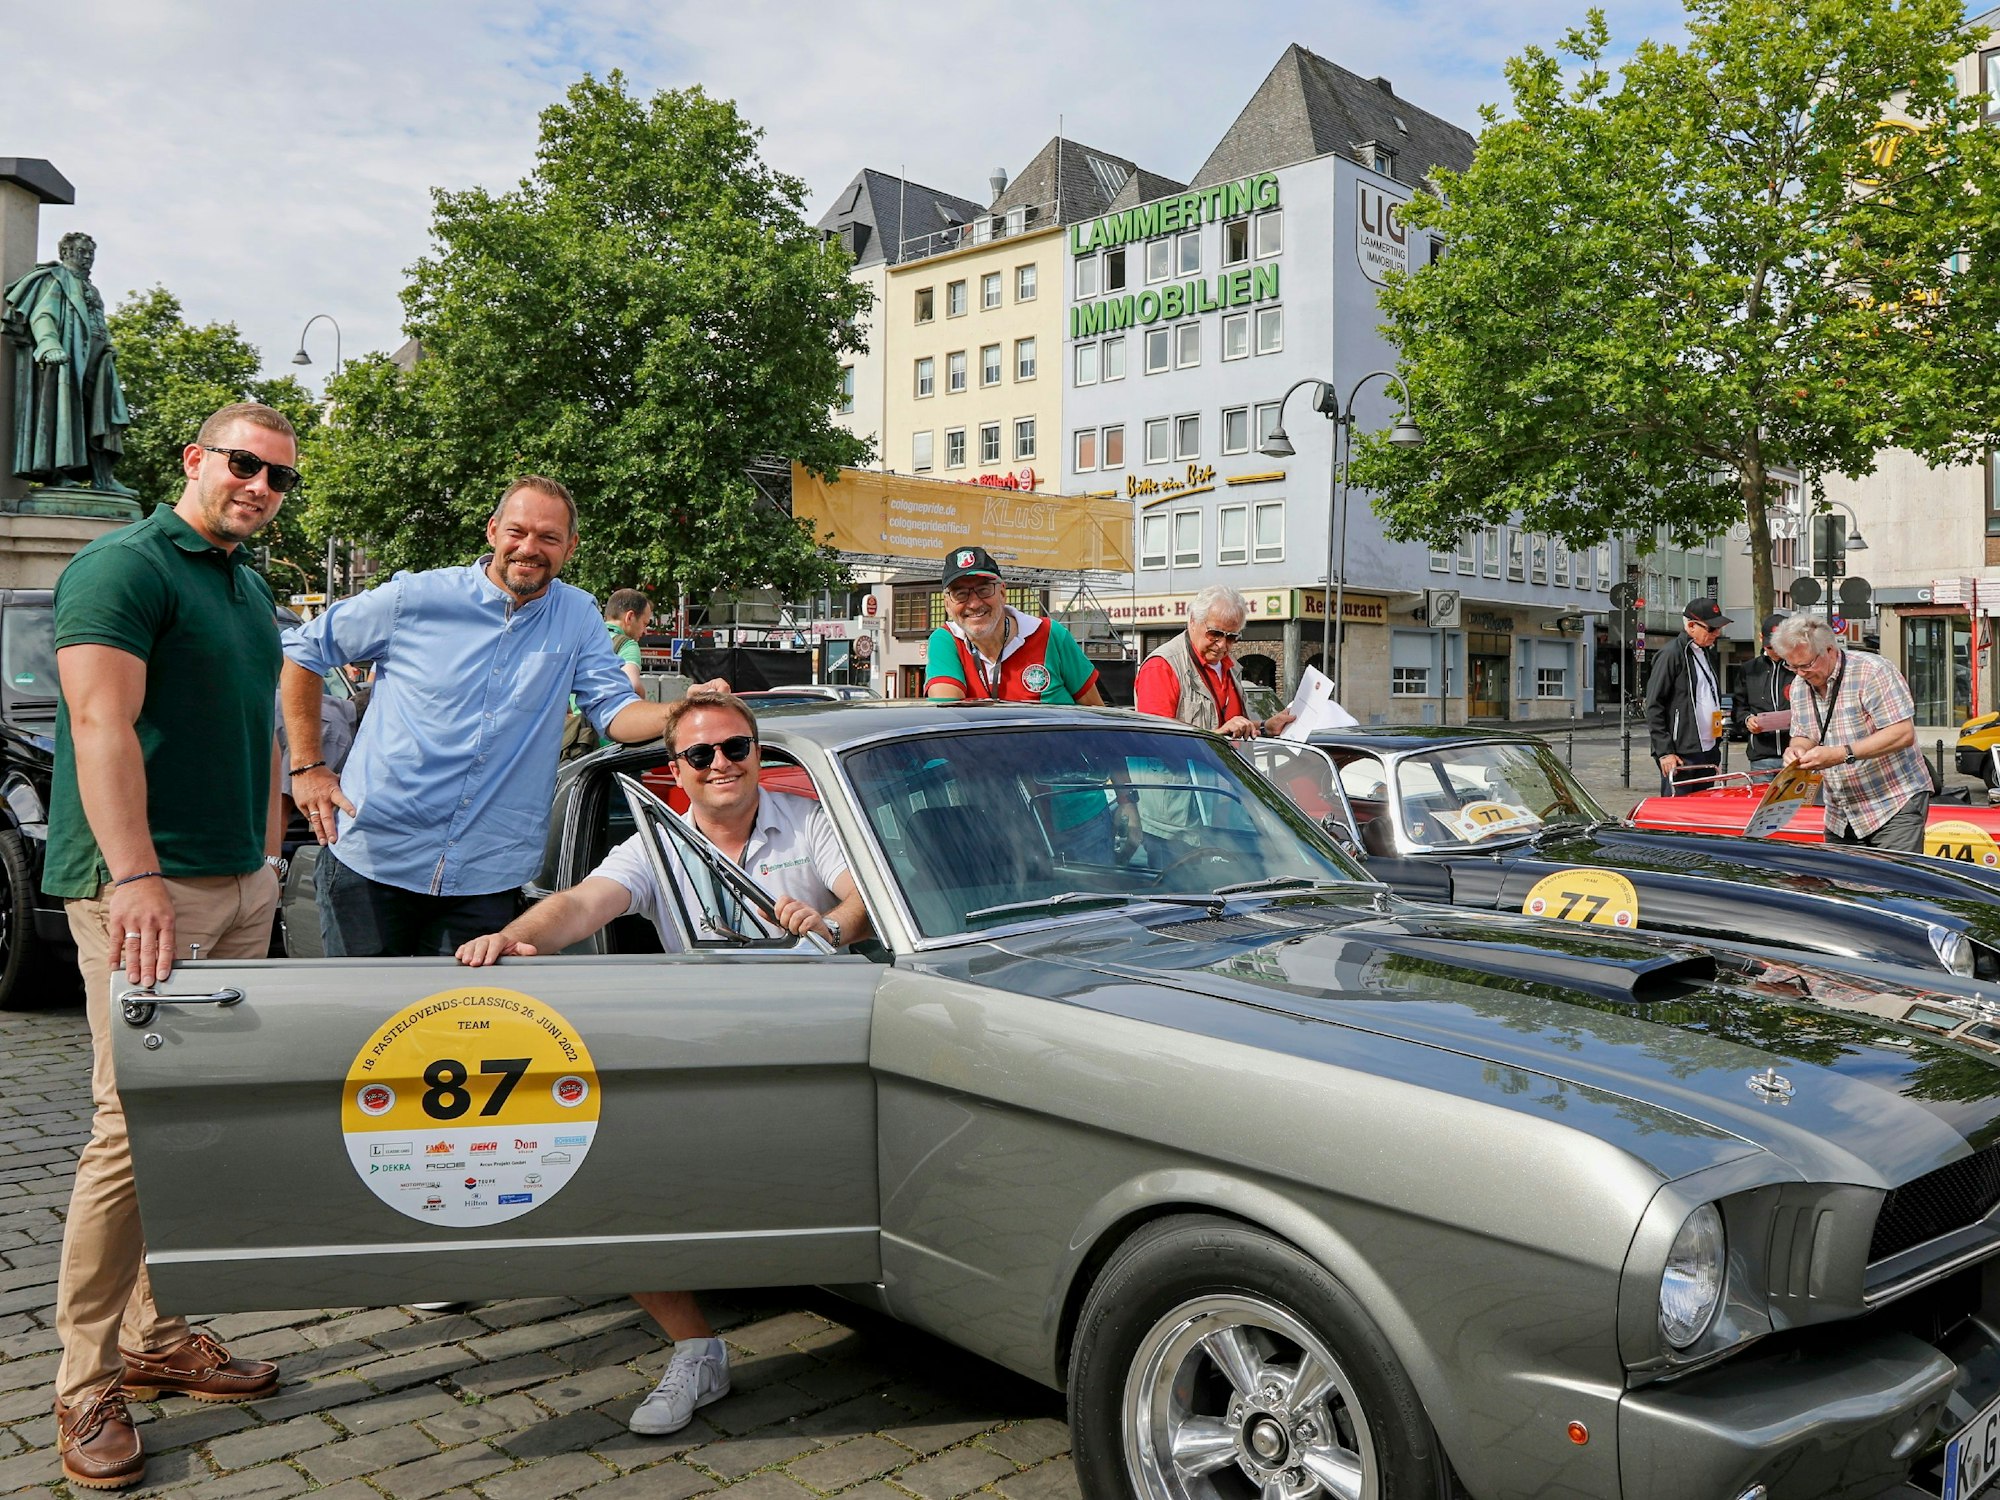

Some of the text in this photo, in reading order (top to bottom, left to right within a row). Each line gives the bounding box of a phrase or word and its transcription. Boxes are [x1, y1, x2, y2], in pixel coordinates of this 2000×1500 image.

[1071, 172, 1279, 255] LAMMERTING
[1361, 188, 1406, 246] LIG
[1360, 234, 1406, 260] LAMMERTING
[1366, 250, 1406, 272] IMMOBILIEN
[1070, 263, 1280, 338] IMMOBILIEN
[1127, 463, 1216, 498] Bitte ein Bit
[890, 498, 957, 516] colognepride.de
[889, 516, 971, 535] cologneprideofficial
[889, 533, 944, 550] colognepride
[1305, 595, 1382, 618] Returant
[1440, 599, 1451, 611] 20
[1478, 808, 1503, 823] 77
[1936, 844, 1975, 863] 44
[1556, 891, 1610, 923] 77
[362, 996, 578, 1072] 18. FASTELOVENDS-CLASSICS 26. JUNI 2022
[458, 1021, 490, 1030] TEAM
[422, 1057, 532, 1121] 87
[514, 1138, 538, 1150] Dom
[382, 1163, 411, 1172] DEKRA
[465, 1200, 488, 1208] Hilton
[1959, 1435, 1973, 1494] K
